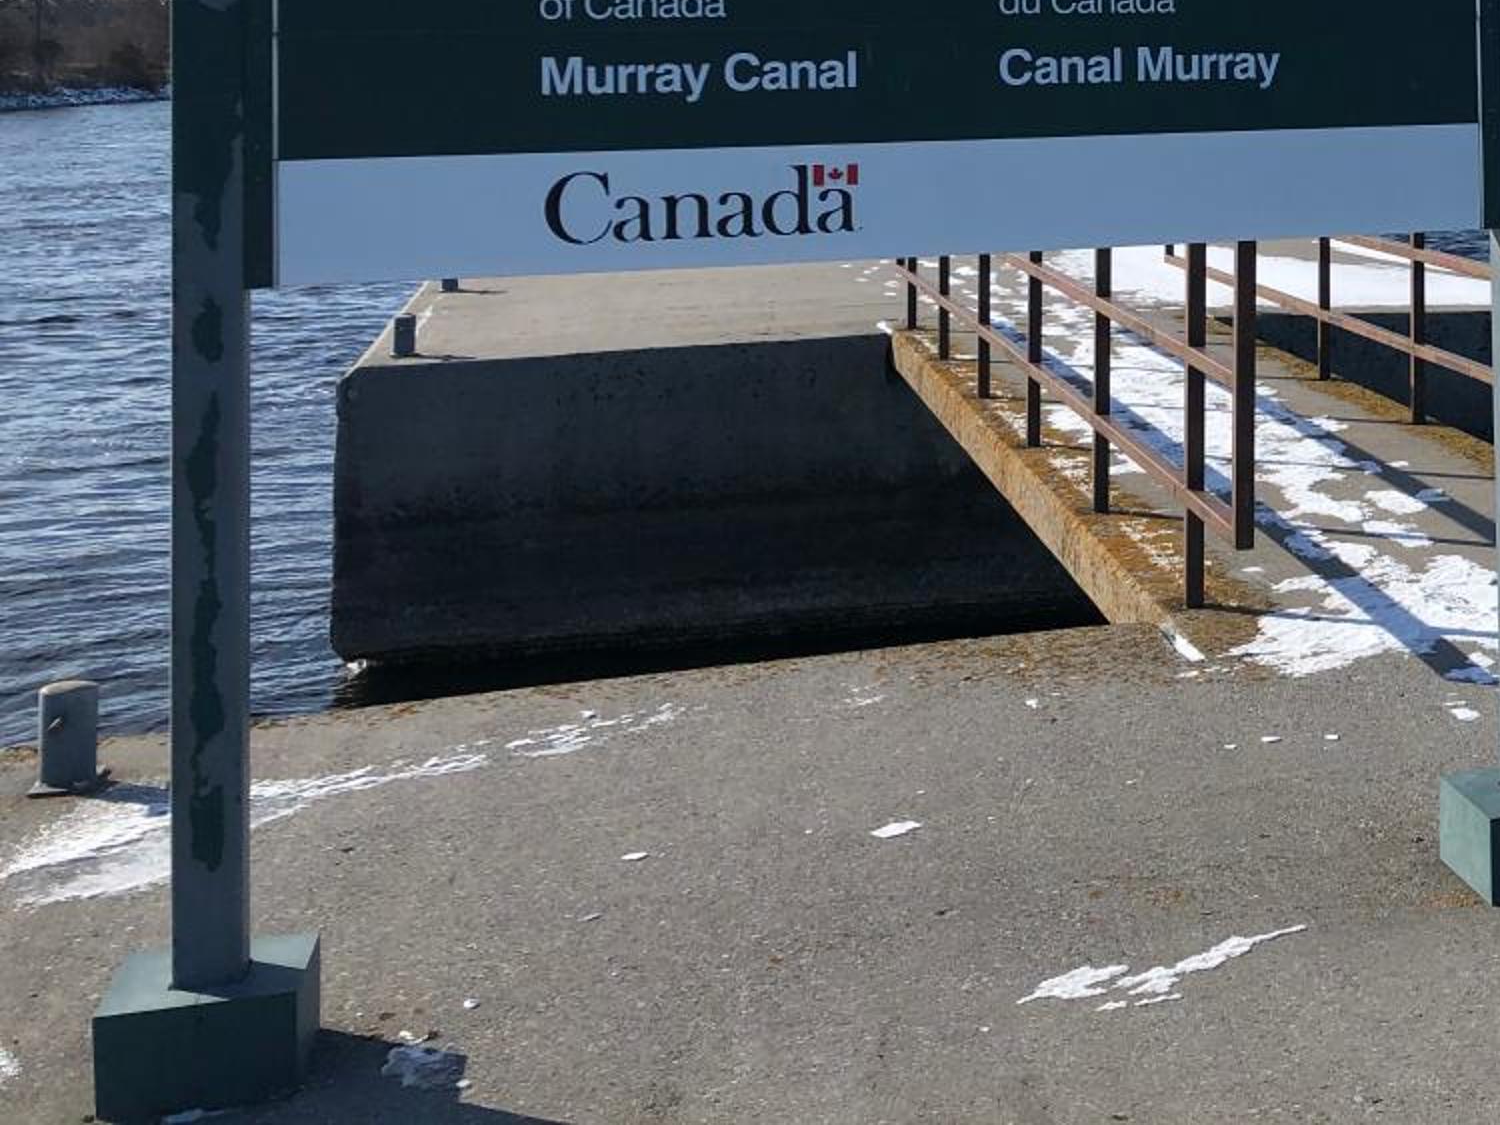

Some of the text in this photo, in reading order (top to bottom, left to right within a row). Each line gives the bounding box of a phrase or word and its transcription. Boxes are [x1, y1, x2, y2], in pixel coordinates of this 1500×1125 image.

[541, 50, 857, 103] Murray Canal
[999, 46, 1281, 89] Canal Murray
[544, 163, 855, 245] Canada
